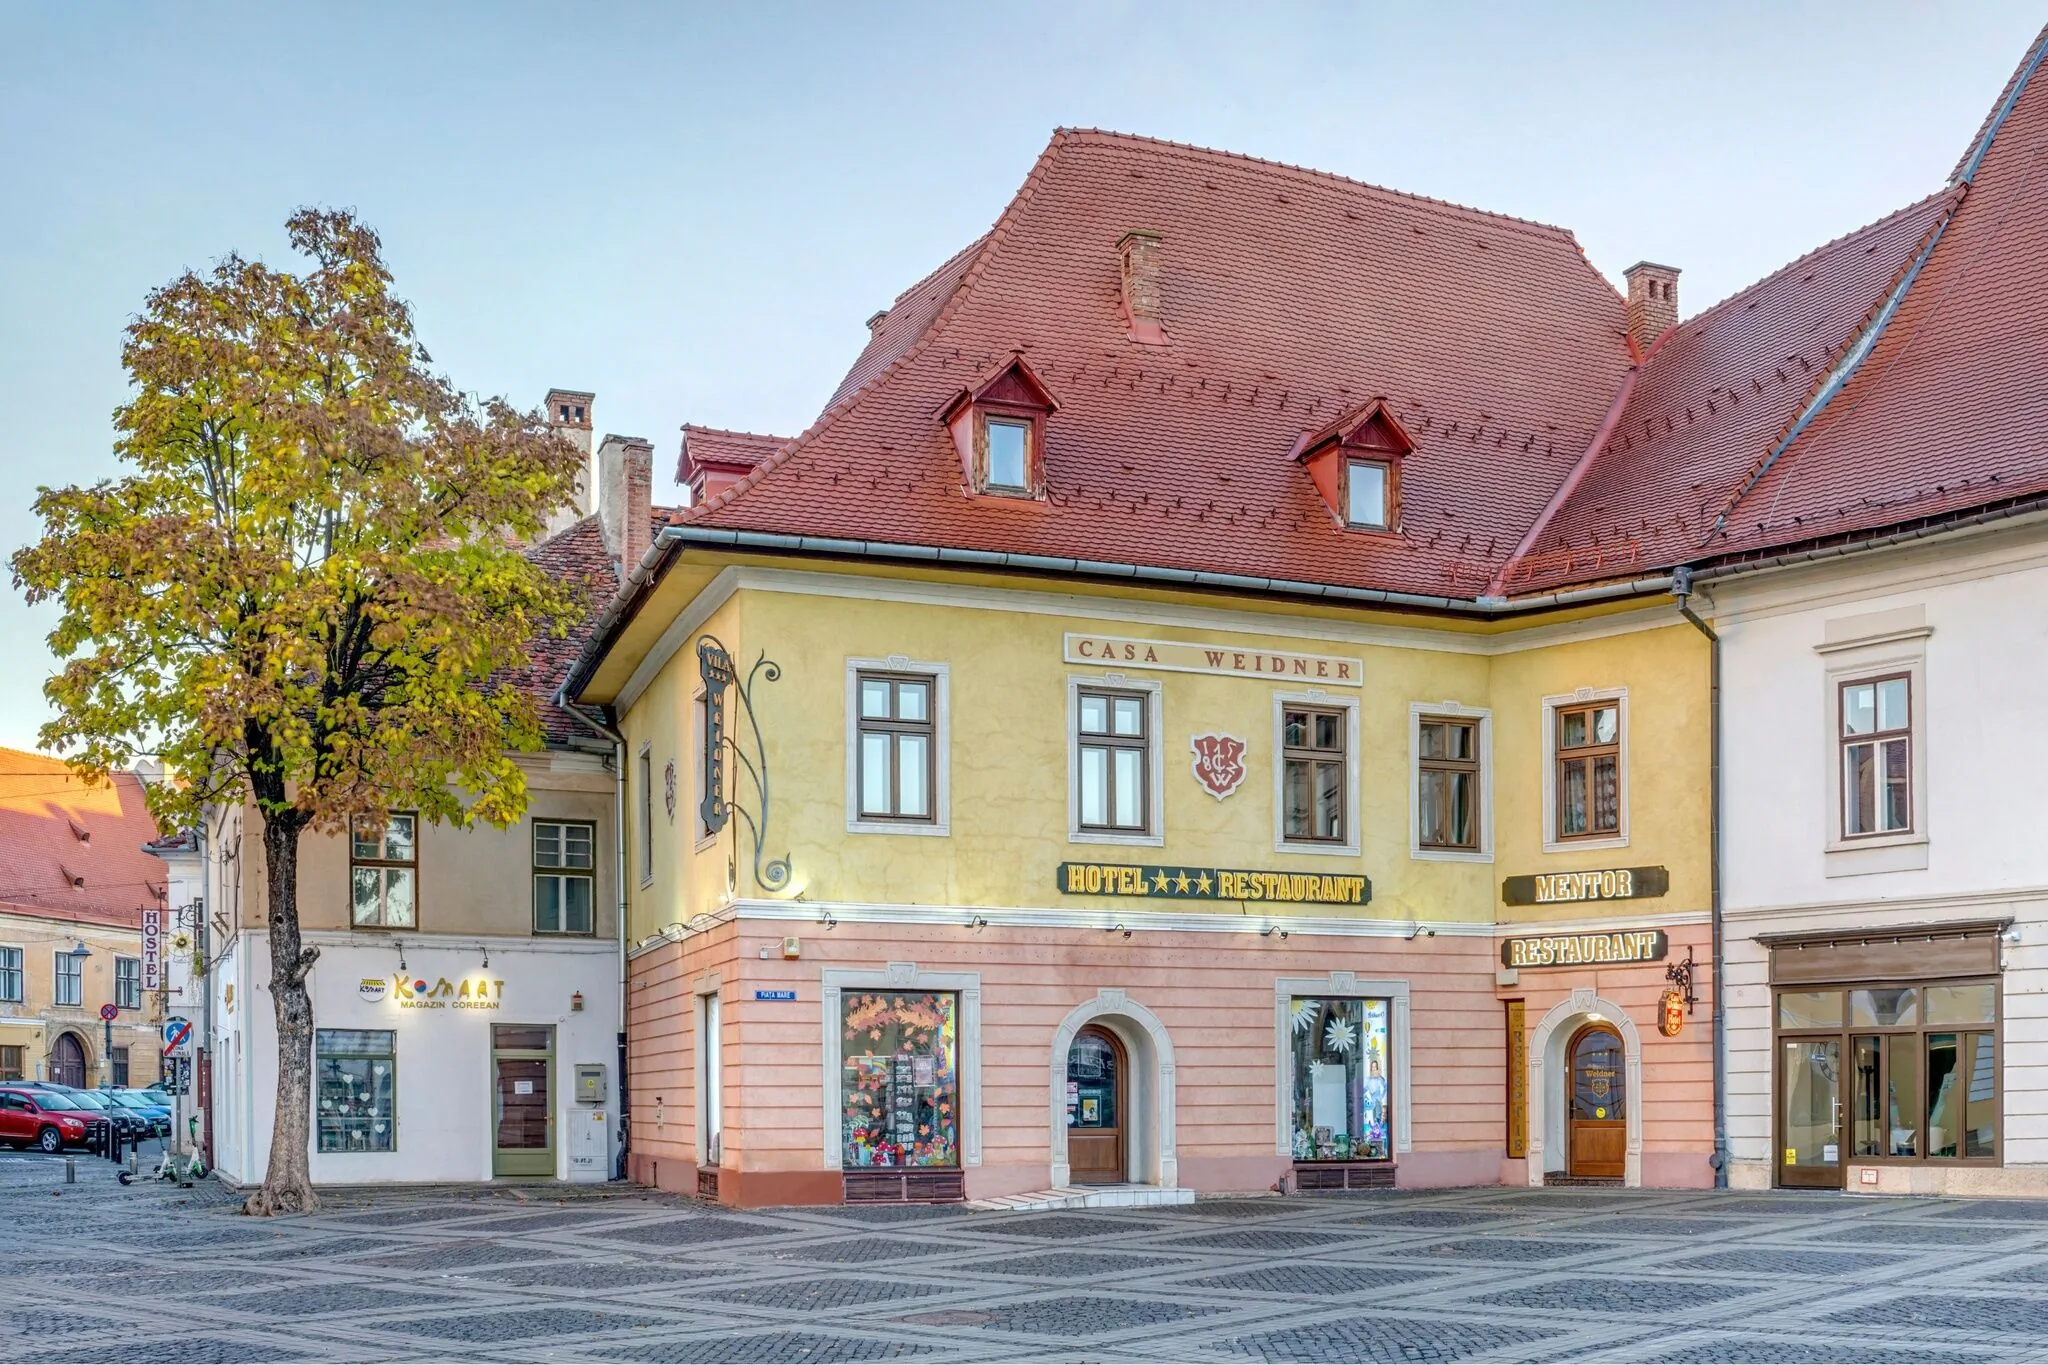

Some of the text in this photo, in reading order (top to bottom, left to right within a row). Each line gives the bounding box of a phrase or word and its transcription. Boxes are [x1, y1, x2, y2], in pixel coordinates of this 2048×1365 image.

[706, 652, 731, 673] VILA
[1078, 640, 1351, 679] CASA WEIDNER
[1067, 864, 1366, 903] HOTEL RESTAURANT
[1535, 869, 1633, 903] MENTOR
[145, 912, 159, 988] HOSTEL
[1510, 931, 1657, 967] RESTAURANT
[400, 1001, 500, 1009] MAGAZIN COREEAN
